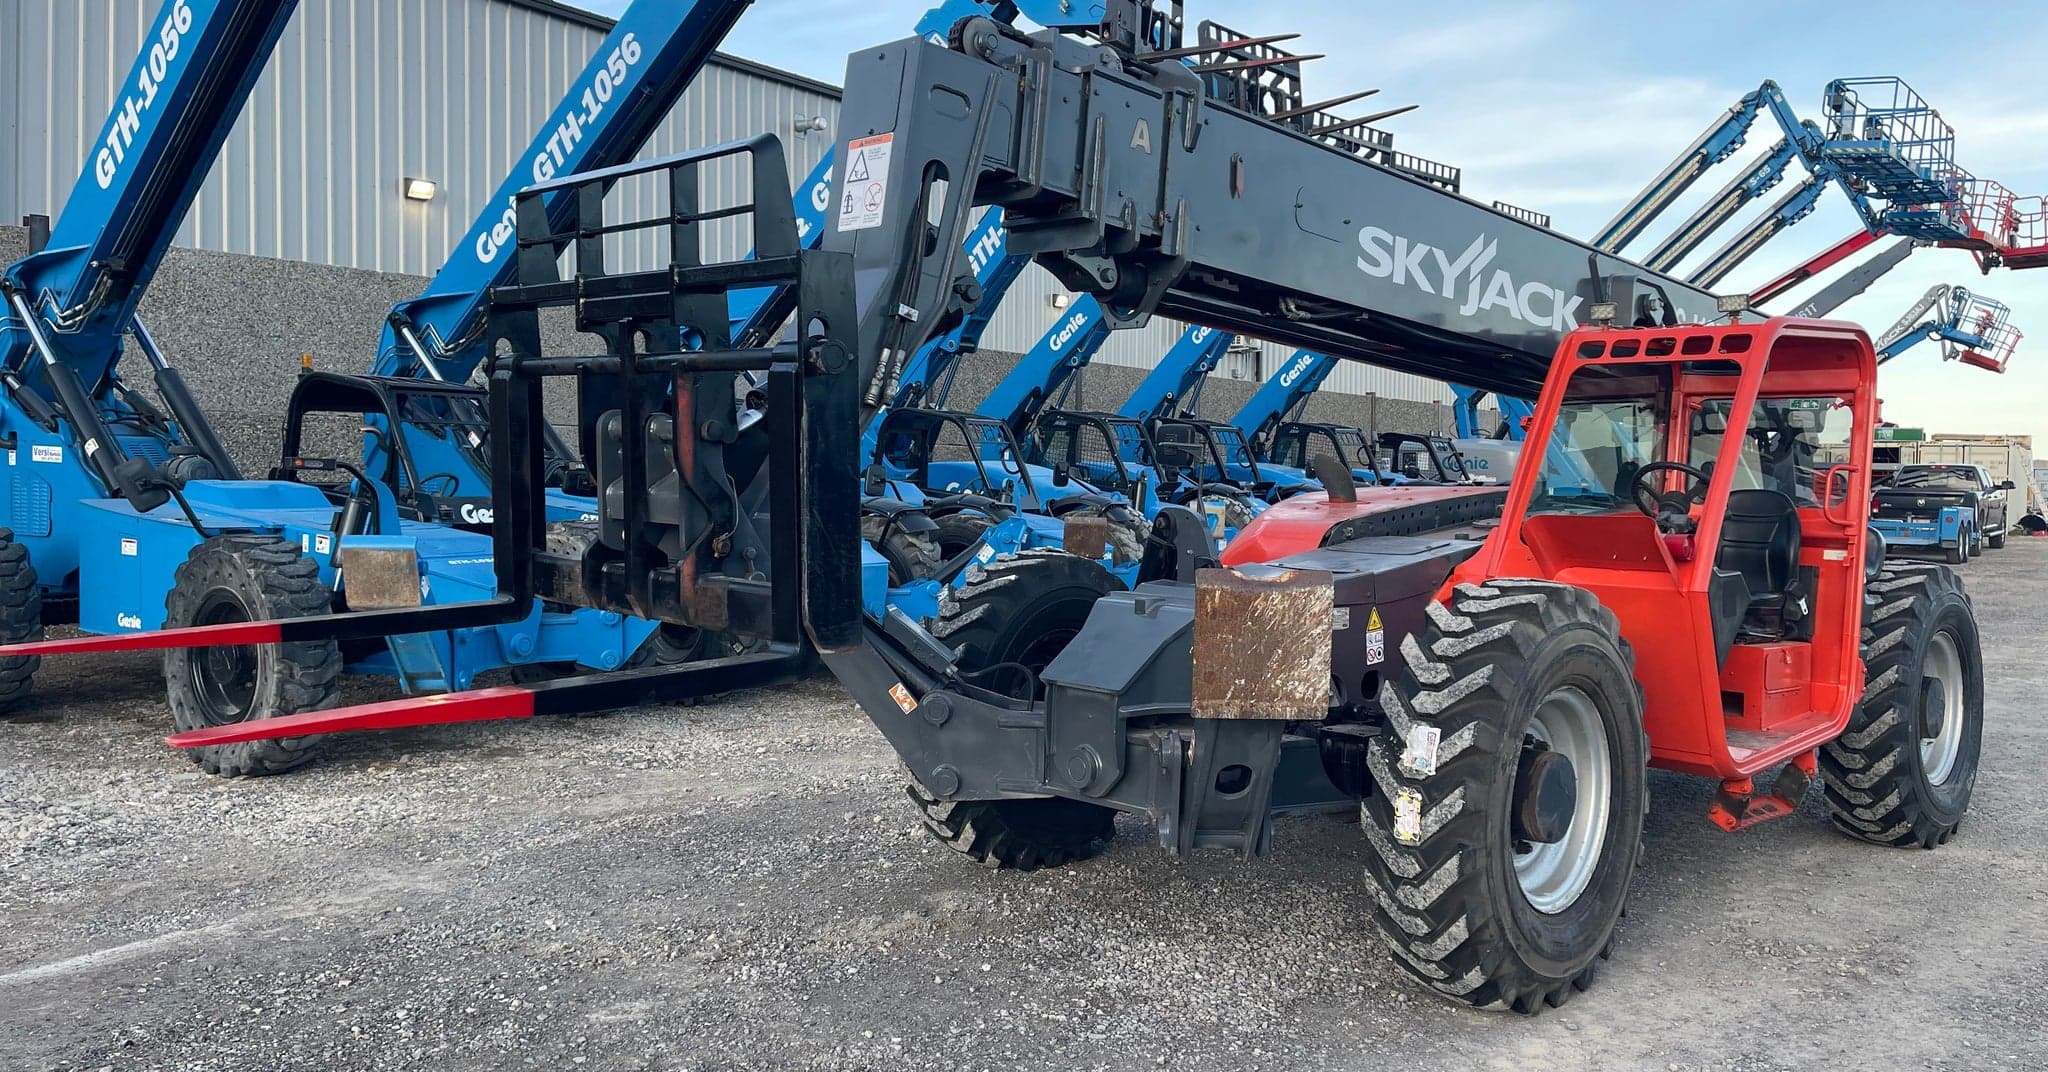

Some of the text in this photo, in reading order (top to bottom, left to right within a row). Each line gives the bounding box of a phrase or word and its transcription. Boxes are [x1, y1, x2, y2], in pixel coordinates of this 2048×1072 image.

[96, 0, 192, 190] GTH-1056
[533, 32, 642, 184] GTH-1056
[1129, 118, 1151, 154] A
[1357, 226, 1584, 332] SKYJACK
[1794, 302, 1818, 318] 61T
[1050, 312, 1088, 351] Genie
[1280, 354, 1314, 387] Genie
[118, 612, 142, 629] Genie
